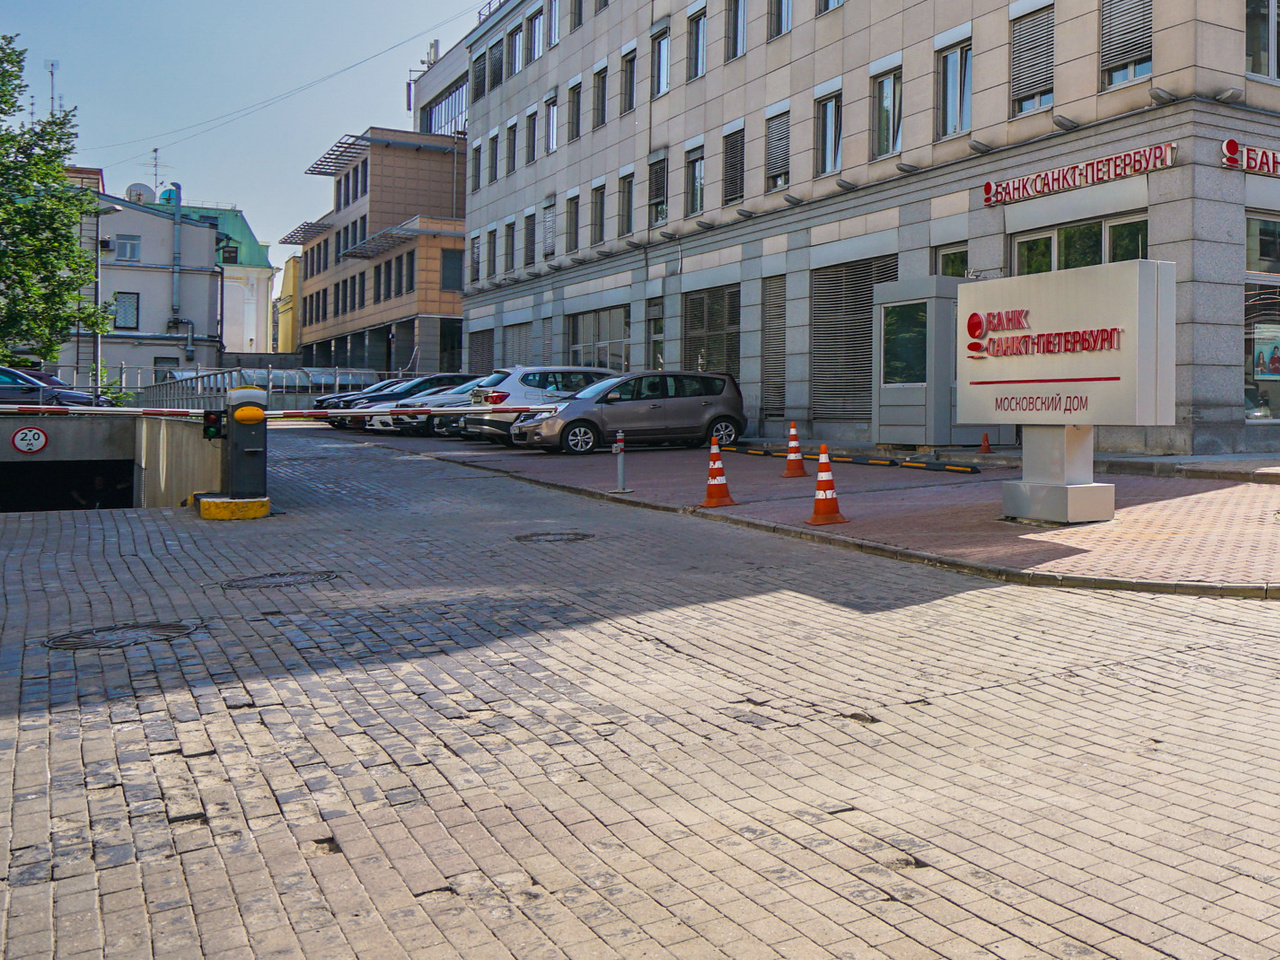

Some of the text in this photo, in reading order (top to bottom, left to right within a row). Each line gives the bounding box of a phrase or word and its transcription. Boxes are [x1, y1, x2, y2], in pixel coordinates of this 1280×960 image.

[995, 143, 1176, 203] БАНК САНКТ-ПЕТЕРБУРГ
[986, 309, 1028, 331] БАНК
[986, 328, 1121, 357] САНКТ-ПЕТЕРБУРГ
[995, 393, 1088, 414] МОСКОВСКИЙ ДОМ
[20, 432, 40, 442] 2,0
